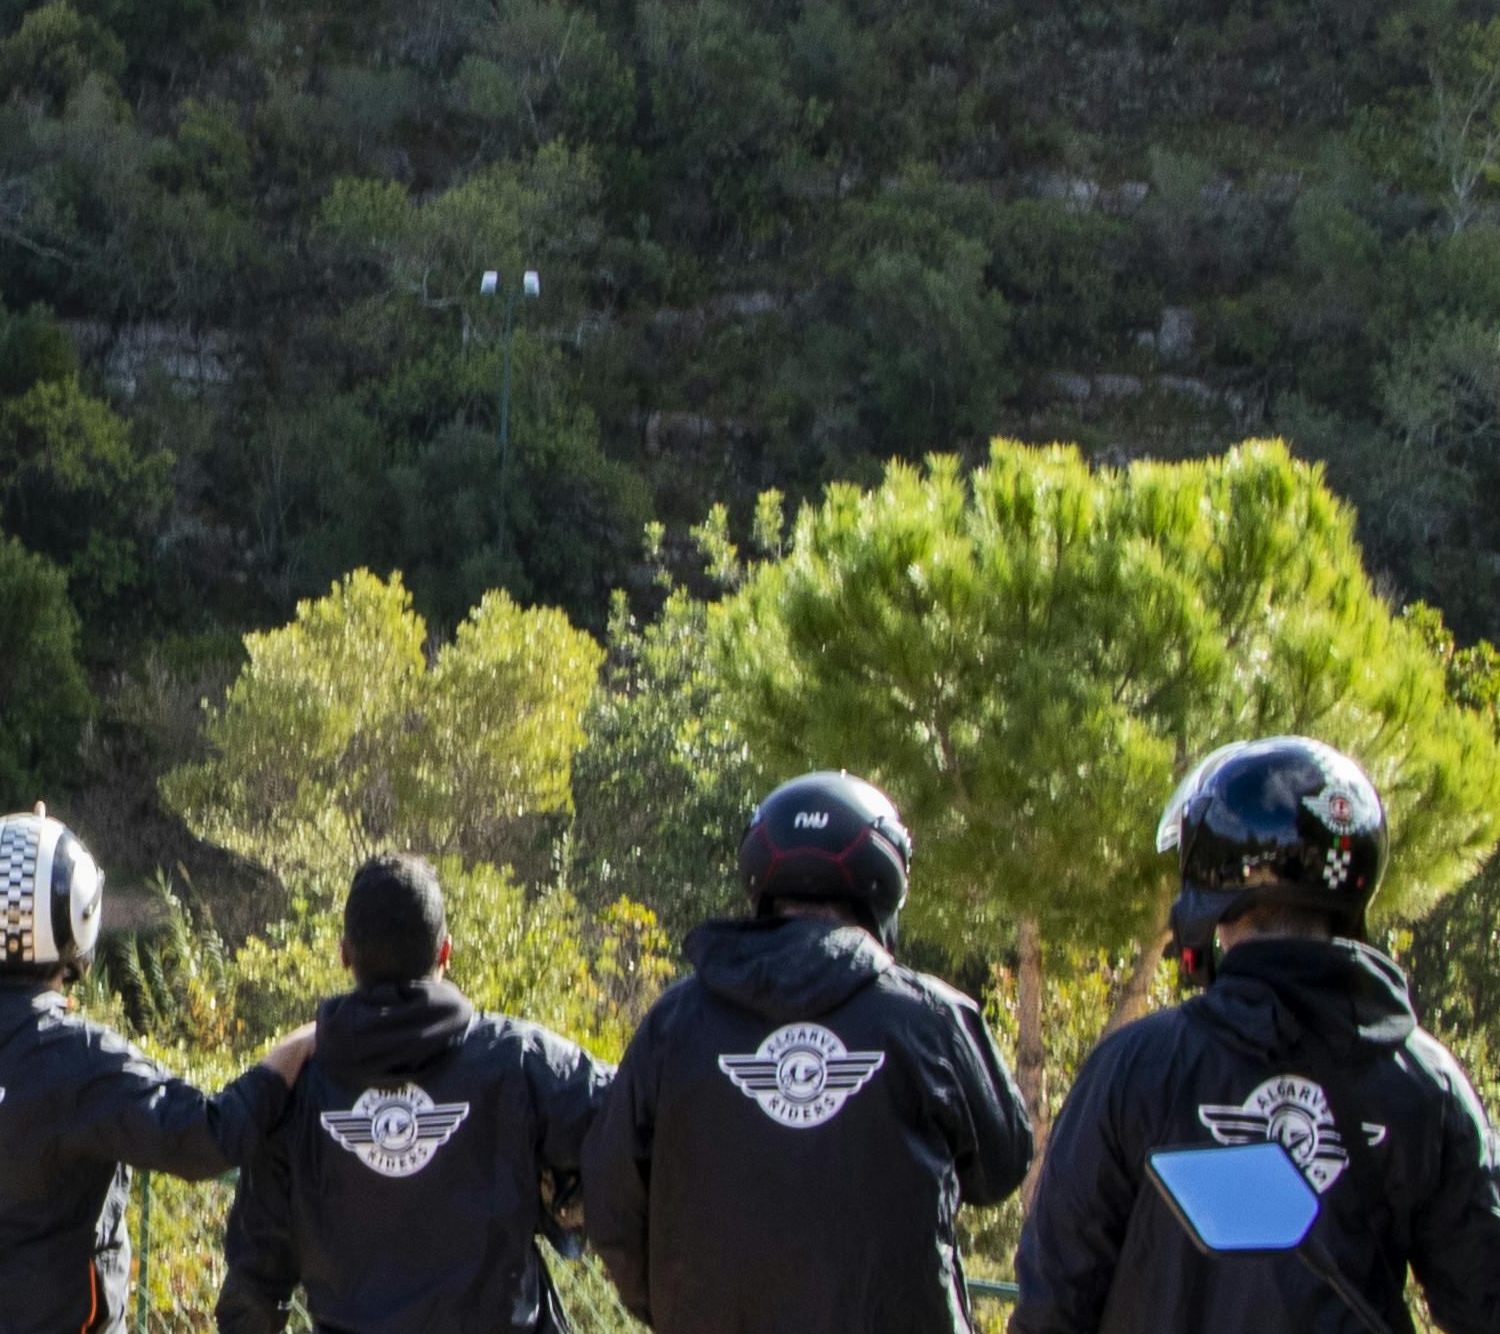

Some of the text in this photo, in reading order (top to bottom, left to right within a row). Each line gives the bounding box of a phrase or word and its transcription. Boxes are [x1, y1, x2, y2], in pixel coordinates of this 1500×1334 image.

[767, 1026, 838, 1058] ALGARVE
[769, 1094, 836, 1122] RIDERS
[369, 1146, 428, 1172] RIDERS
